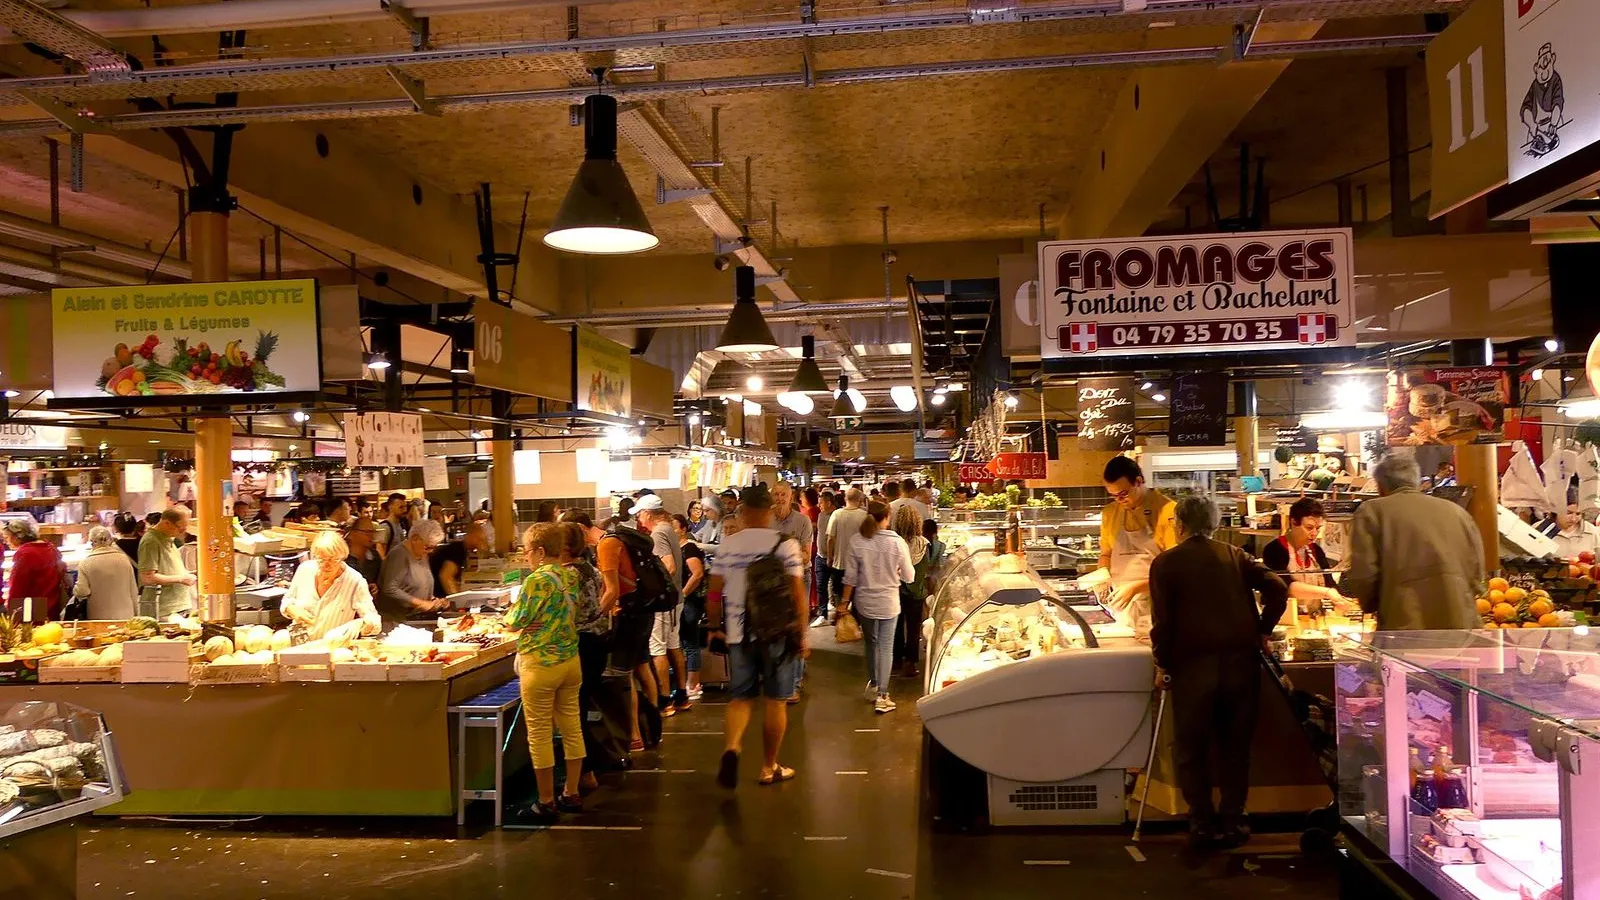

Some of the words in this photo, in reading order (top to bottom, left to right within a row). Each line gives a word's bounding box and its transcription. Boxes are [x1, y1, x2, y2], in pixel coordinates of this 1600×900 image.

[1446, 46, 1489, 153] 11
[1056, 239, 1336, 290] FROMAGES
[63, 295, 106, 312] Alain
[111, 294, 129, 311] et
[213, 288, 304, 306] CAROTTE
[1054, 286, 1168, 317] Fontaine
[1173, 290, 1197, 311] et
[1202, 278, 1340, 311] Bachelard
[115, 318, 158, 332] Fruits
[163, 318, 174, 331] &
[179, 315, 250, 333] Légumes
[1112, 326, 1140, 344] 04
[1148, 325, 1176, 344] 79
[1184, 324, 1211, 343] 35
[1219, 323, 1247, 341] 70
[1255, 322, 1282, 340] 35
[479, 321, 502, 364] 06
[842, 440, 858, 452] 24
[1177, 433, 1209, 442] EXTRA
